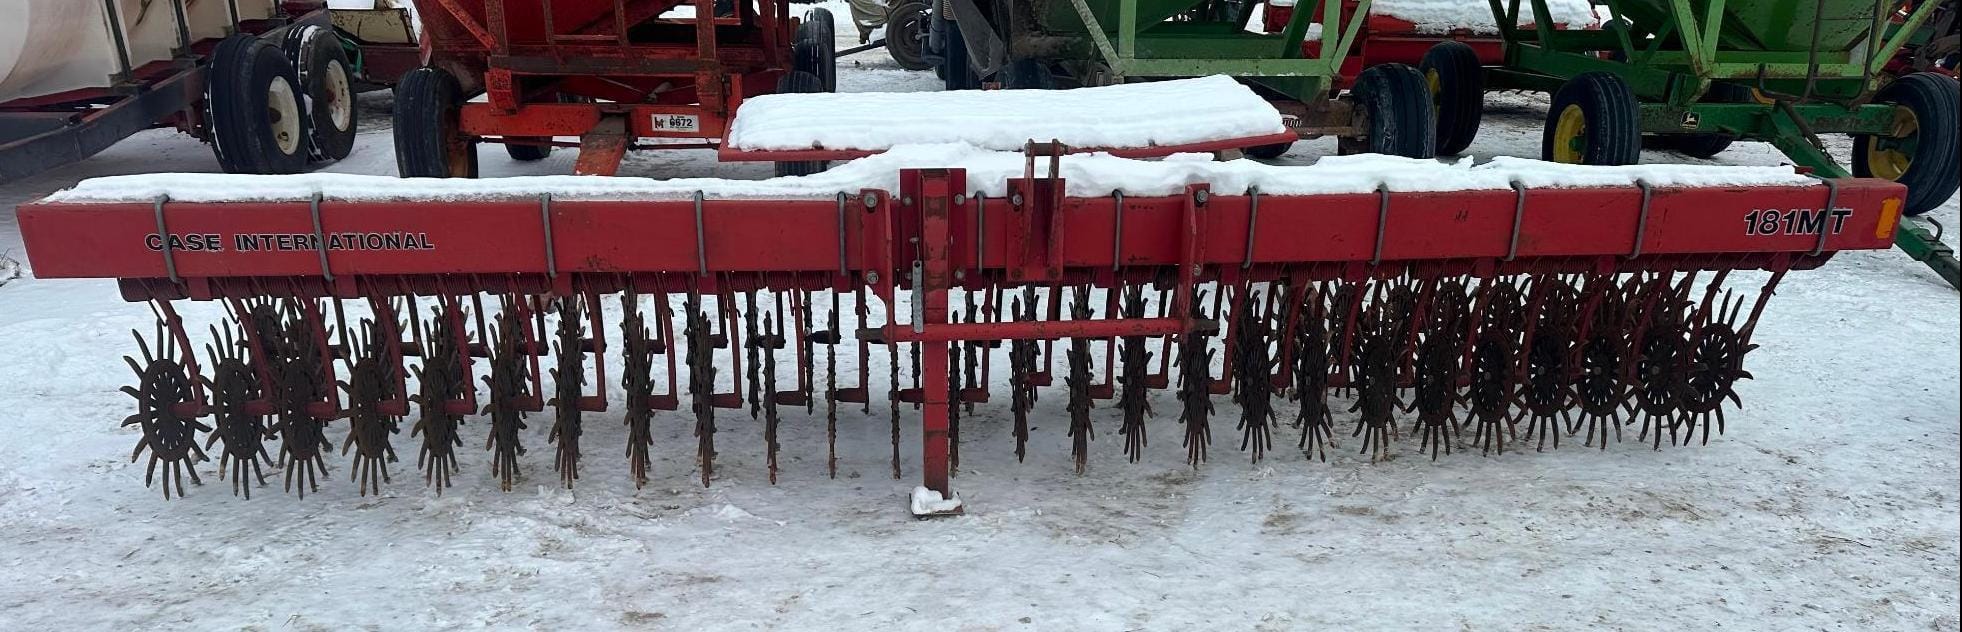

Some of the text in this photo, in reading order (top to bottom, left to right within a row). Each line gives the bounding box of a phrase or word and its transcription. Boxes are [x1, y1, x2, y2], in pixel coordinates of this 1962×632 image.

[1744, 209, 1853, 236] 181MT
[144, 232, 435, 252] CASE INTERNATIONAL
